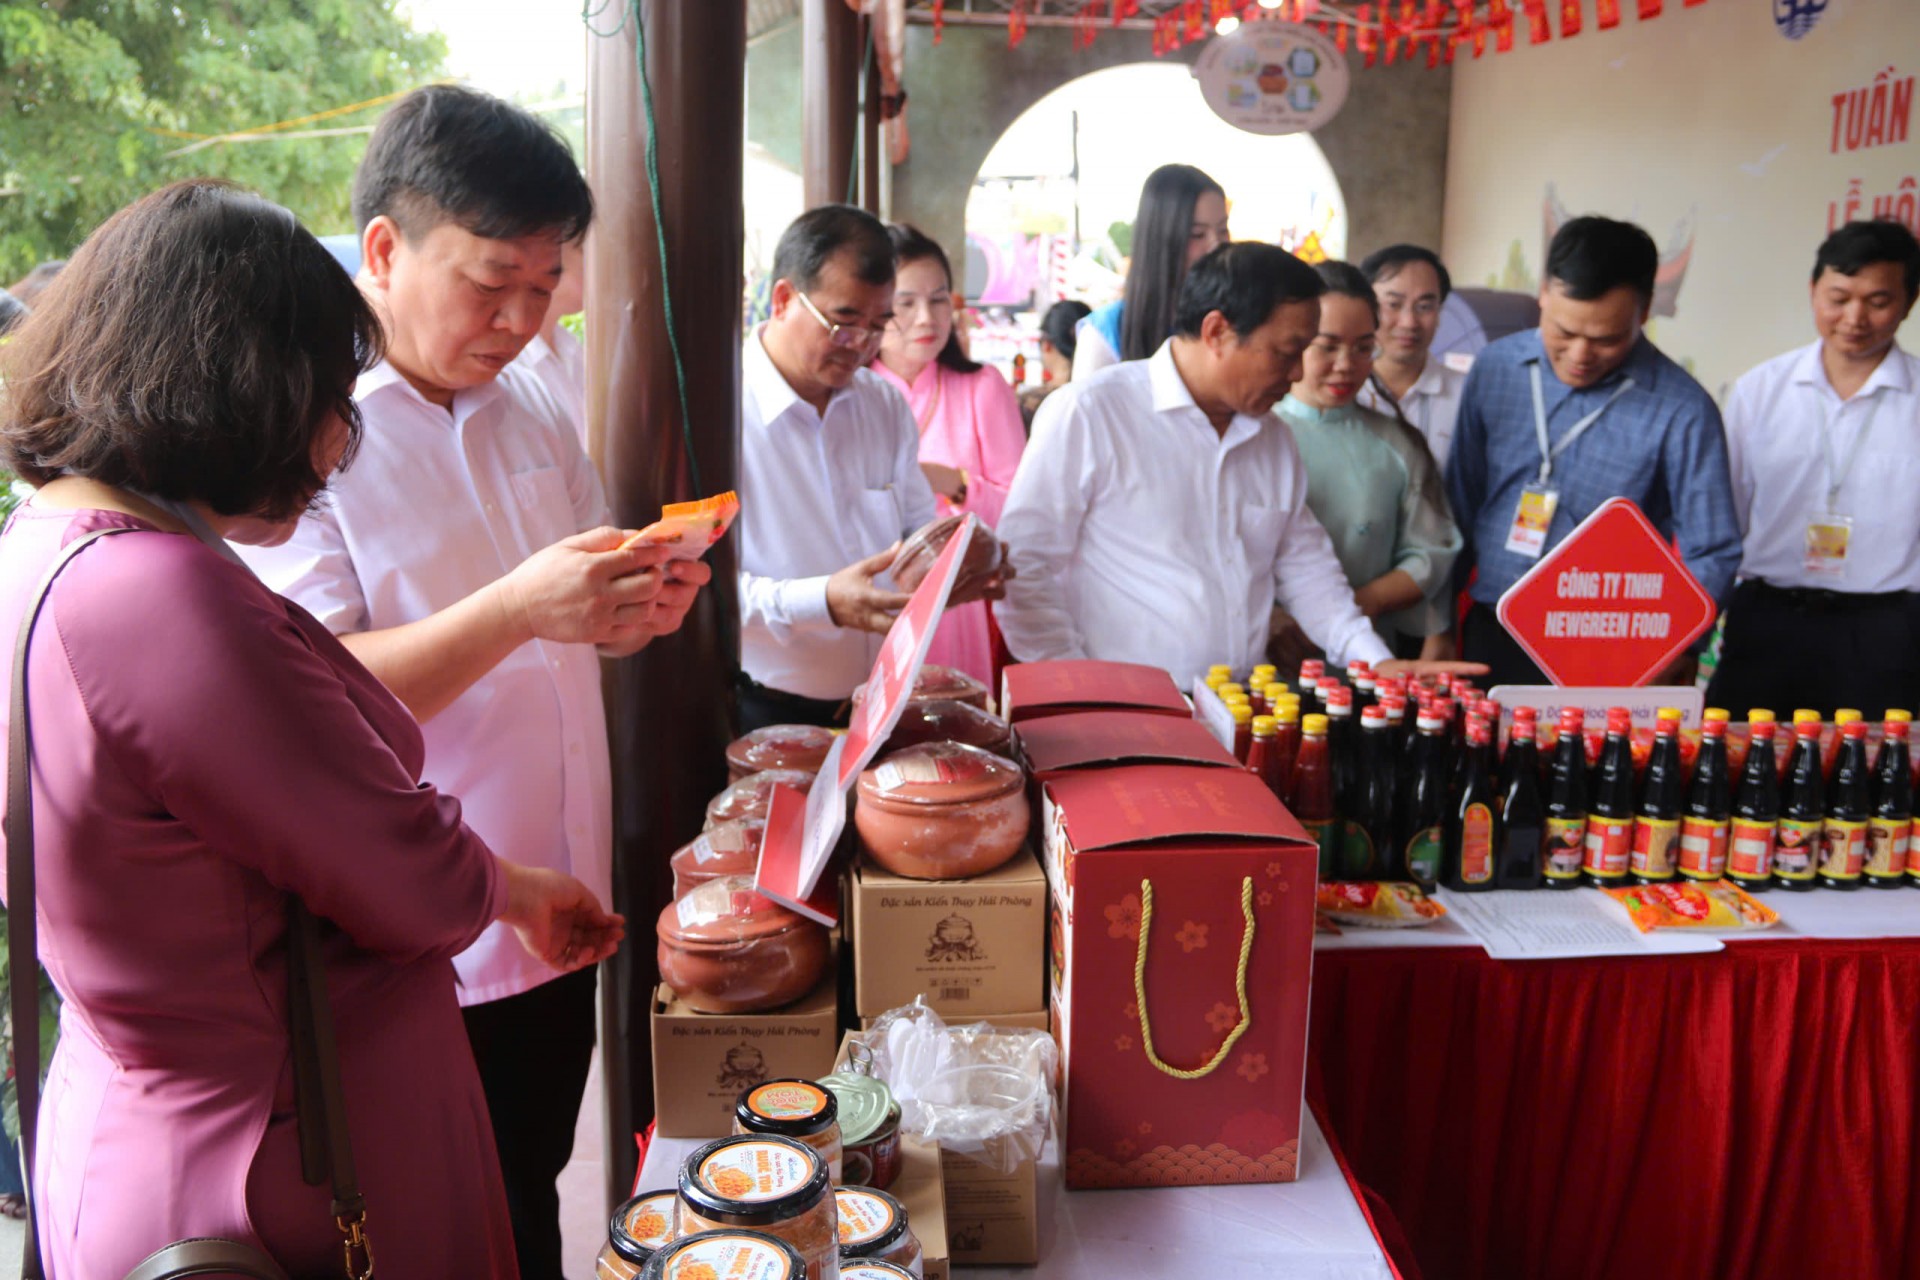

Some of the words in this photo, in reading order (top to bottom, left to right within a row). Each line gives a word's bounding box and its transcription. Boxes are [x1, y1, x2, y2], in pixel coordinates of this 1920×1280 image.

[1557, 566, 1600, 599] CÔNG
[1602, 571, 1621, 599] TY
[1623, 572, 1663, 599] TNHH
[1543, 610, 1630, 638] NEWGREEN
[1631, 612, 1670, 638] FOOD
